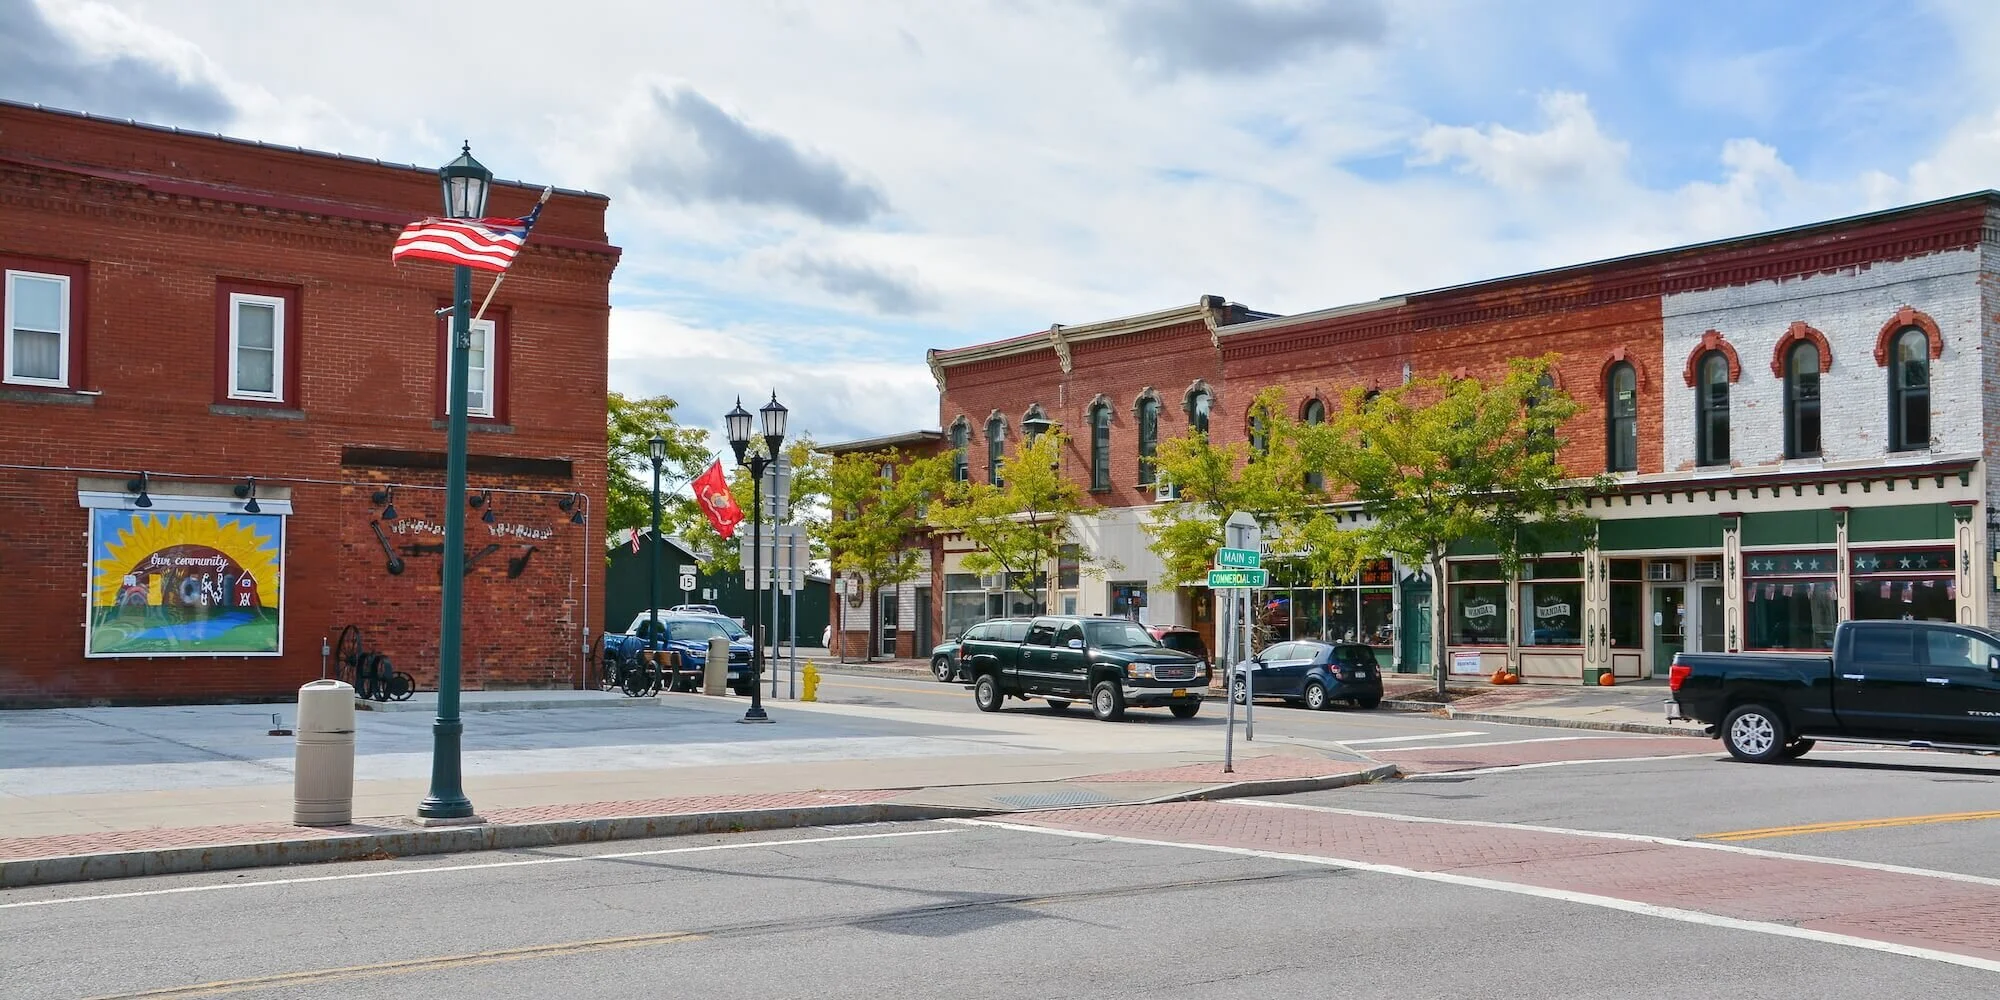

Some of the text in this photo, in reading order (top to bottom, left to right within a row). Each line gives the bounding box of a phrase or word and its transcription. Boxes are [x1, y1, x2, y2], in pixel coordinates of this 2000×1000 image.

[151, 553, 229, 572] Our community
[1224, 551, 1256, 565] MAIN ST
[684, 577, 693, 588] 15
[1212, 573, 1260, 584] COMMERCIAL ST
[1468, 605, 1494, 617] WANDA'S
[1540, 605, 1567, 617] WANDA'S
